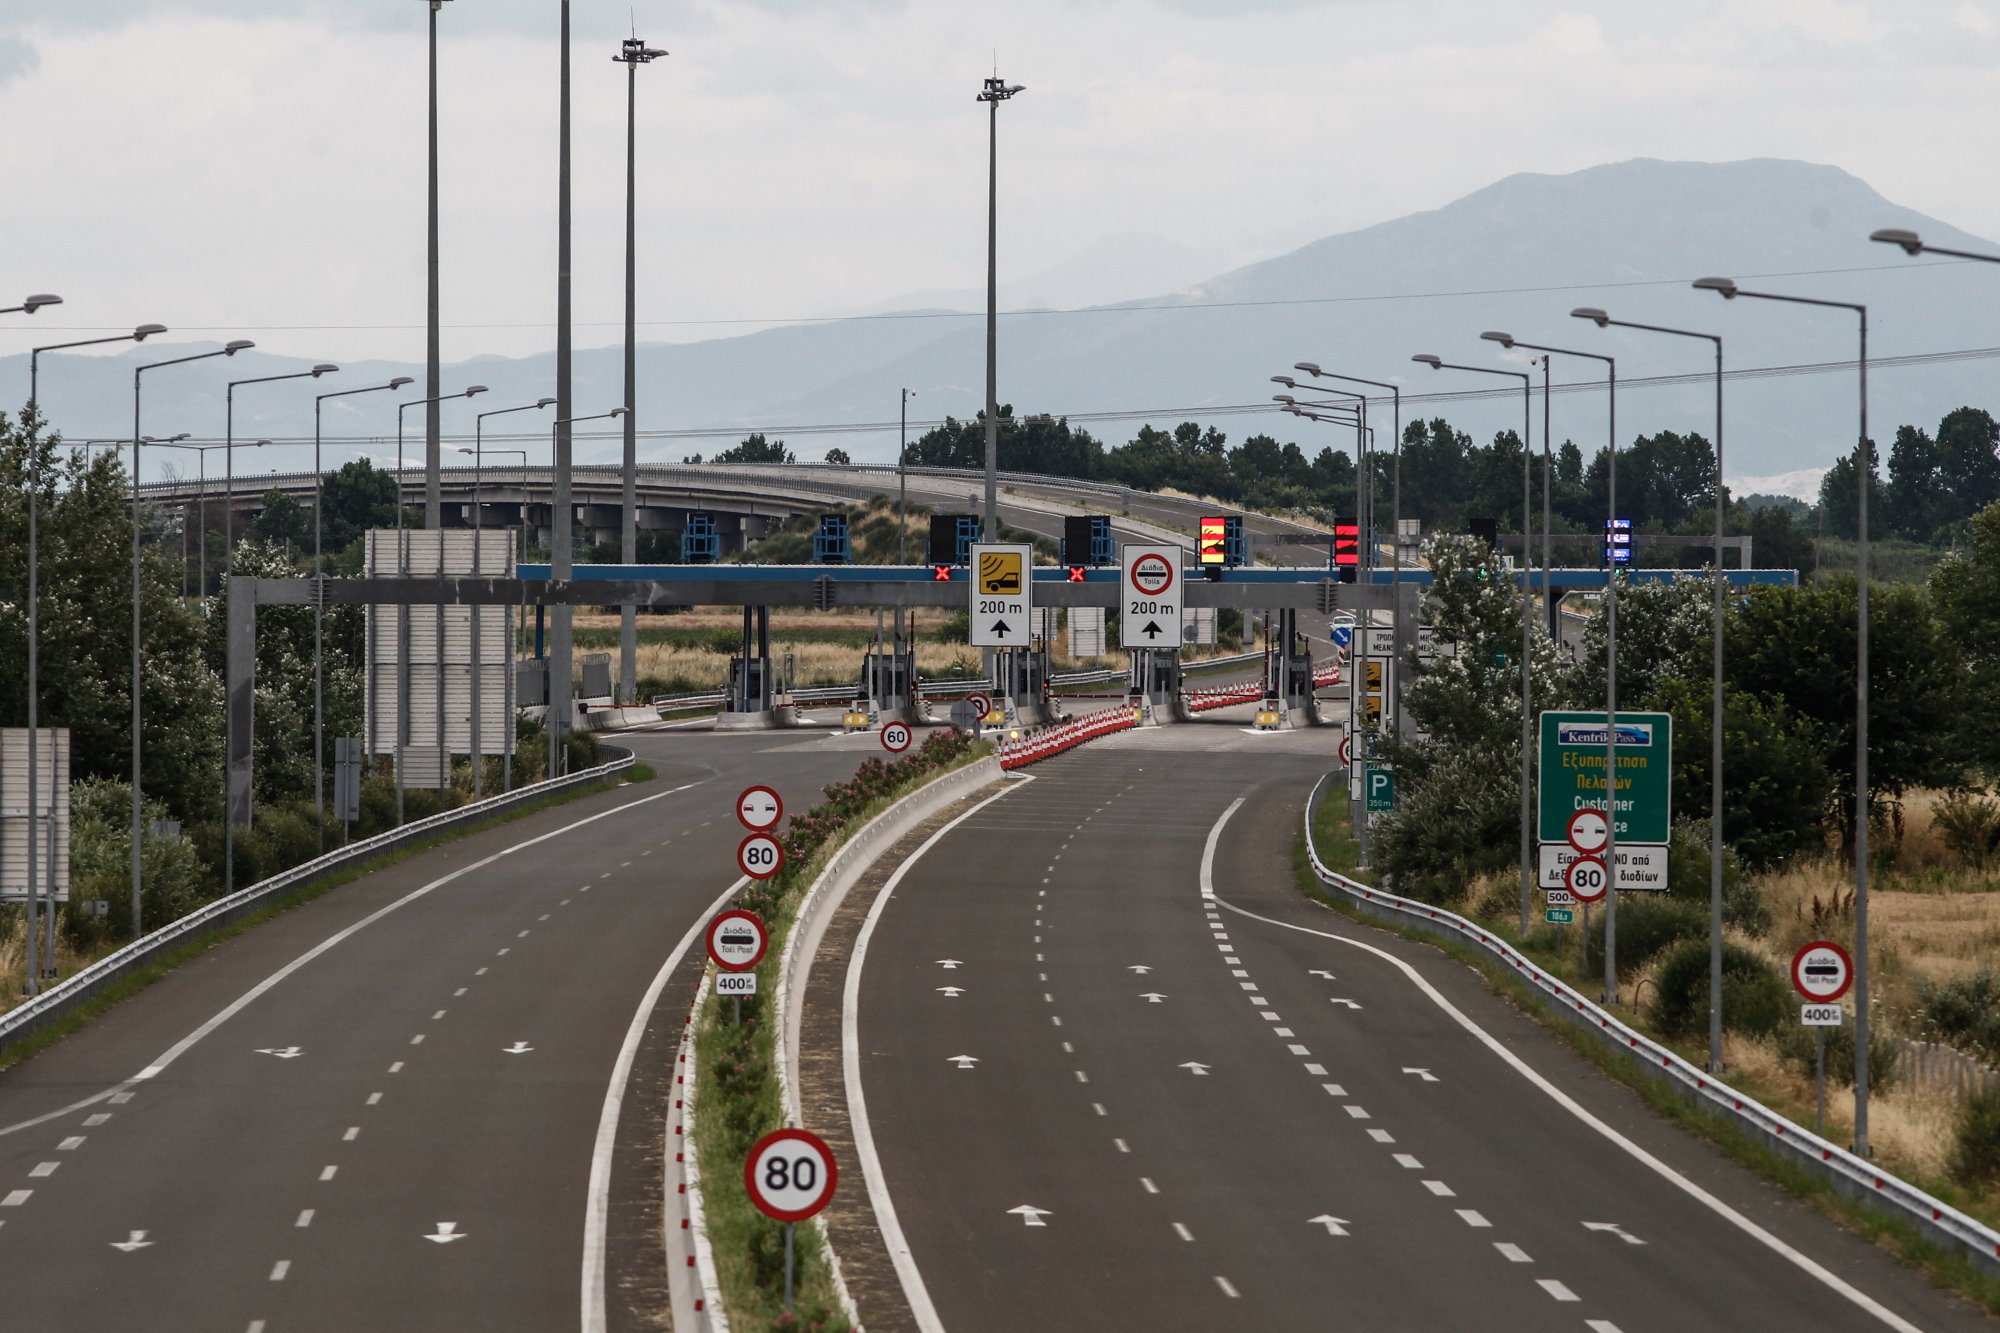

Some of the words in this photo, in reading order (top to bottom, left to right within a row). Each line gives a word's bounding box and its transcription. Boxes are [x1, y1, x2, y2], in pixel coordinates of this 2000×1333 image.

[980, 600, 1005, 614] 200
[1009, 604, 1022, 614] m
[1131, 601, 1157, 614] 200
[1160, 604, 1174, 614] m
[887, 731, 905, 743] 60
[1372, 774, 1388, 797] P
[747, 847, 773, 865] 80
[1632, 854, 1650, 866] από
[1575, 869, 1601, 888] 80
[1620, 870, 1659, 882] διοδίων
[1549, 892, 1569, 902] 500
[719, 978, 745, 990] 400
[1804, 1009, 1831, 1020] 400
[765, 1155, 816, 1191] 80
